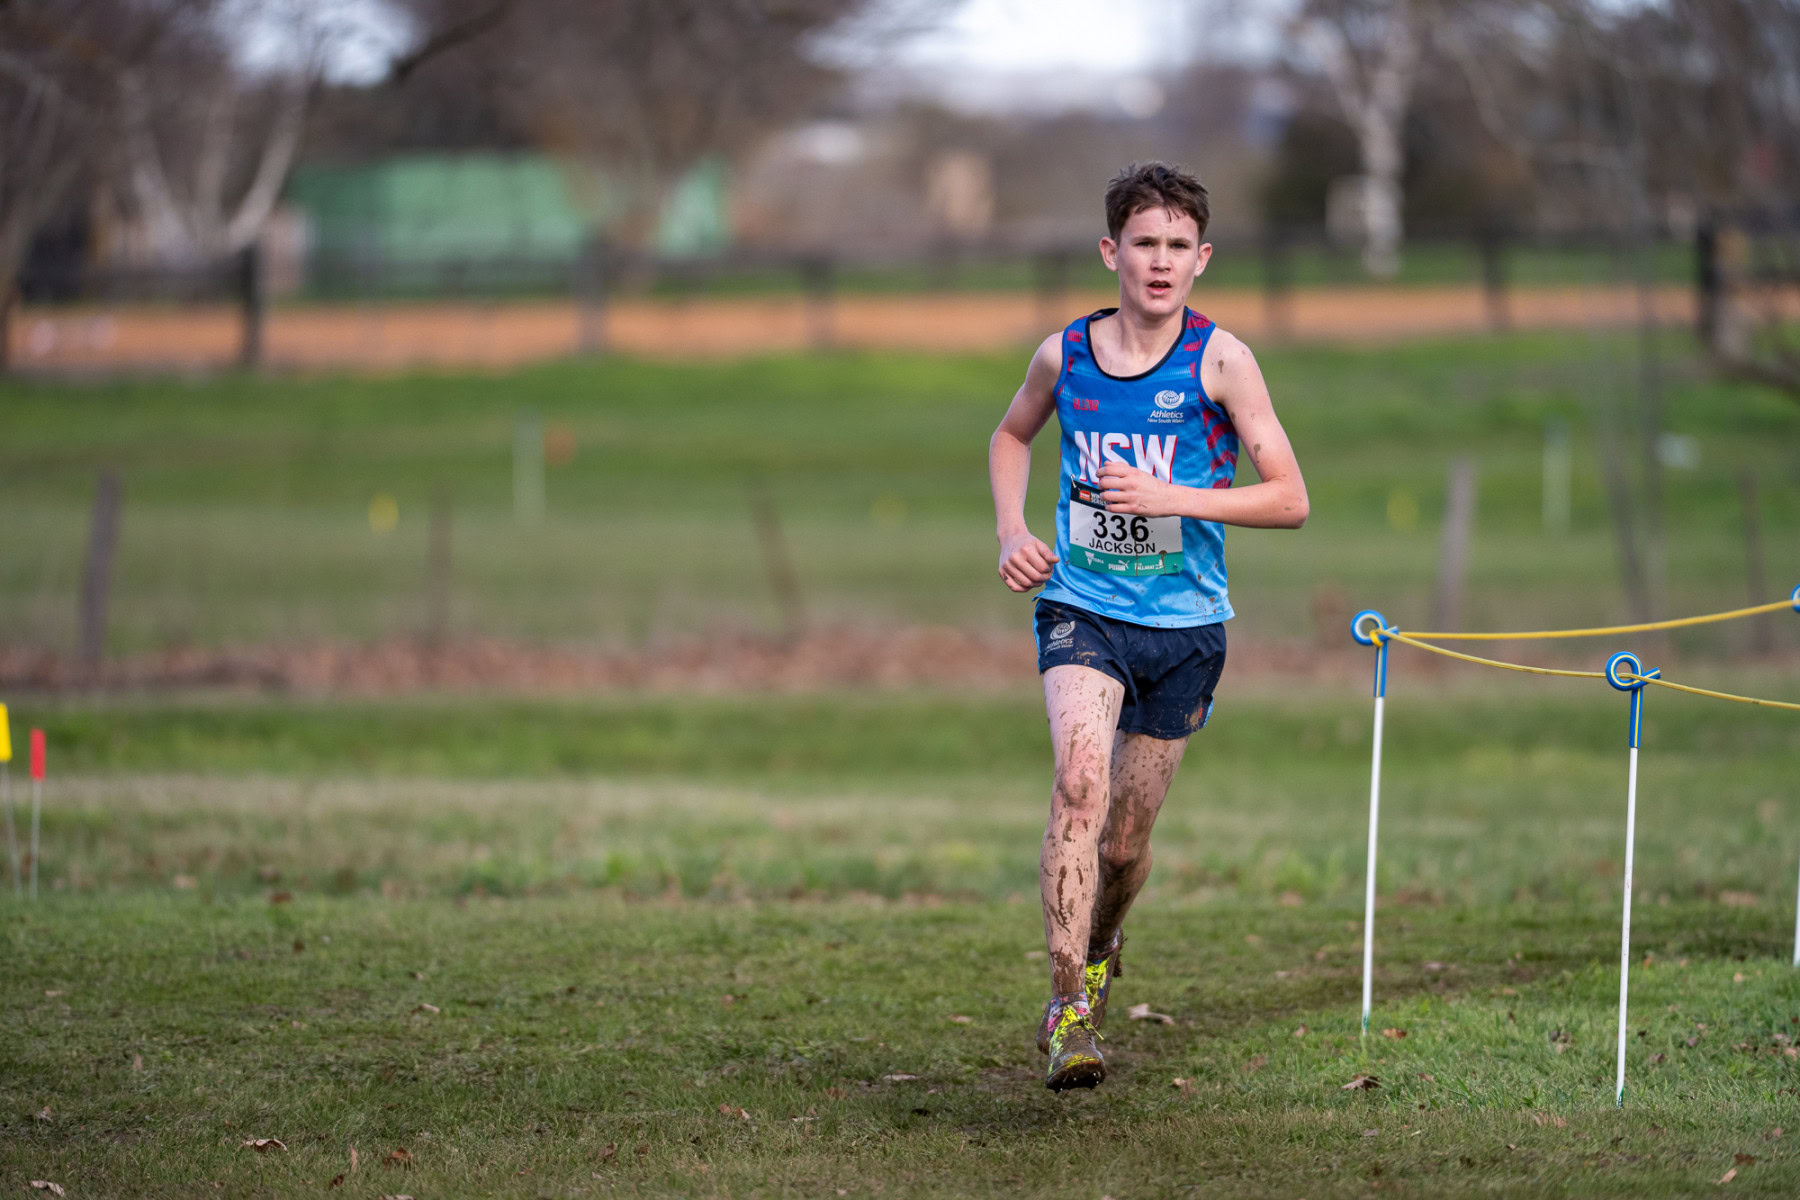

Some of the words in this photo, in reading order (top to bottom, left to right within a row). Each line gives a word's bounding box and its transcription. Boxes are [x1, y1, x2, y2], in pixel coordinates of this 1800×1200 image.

[1150, 409, 1184, 419] Athletics
[1093, 511, 1150, 542] 336
[1089, 538, 1156, 554] JACKSON
